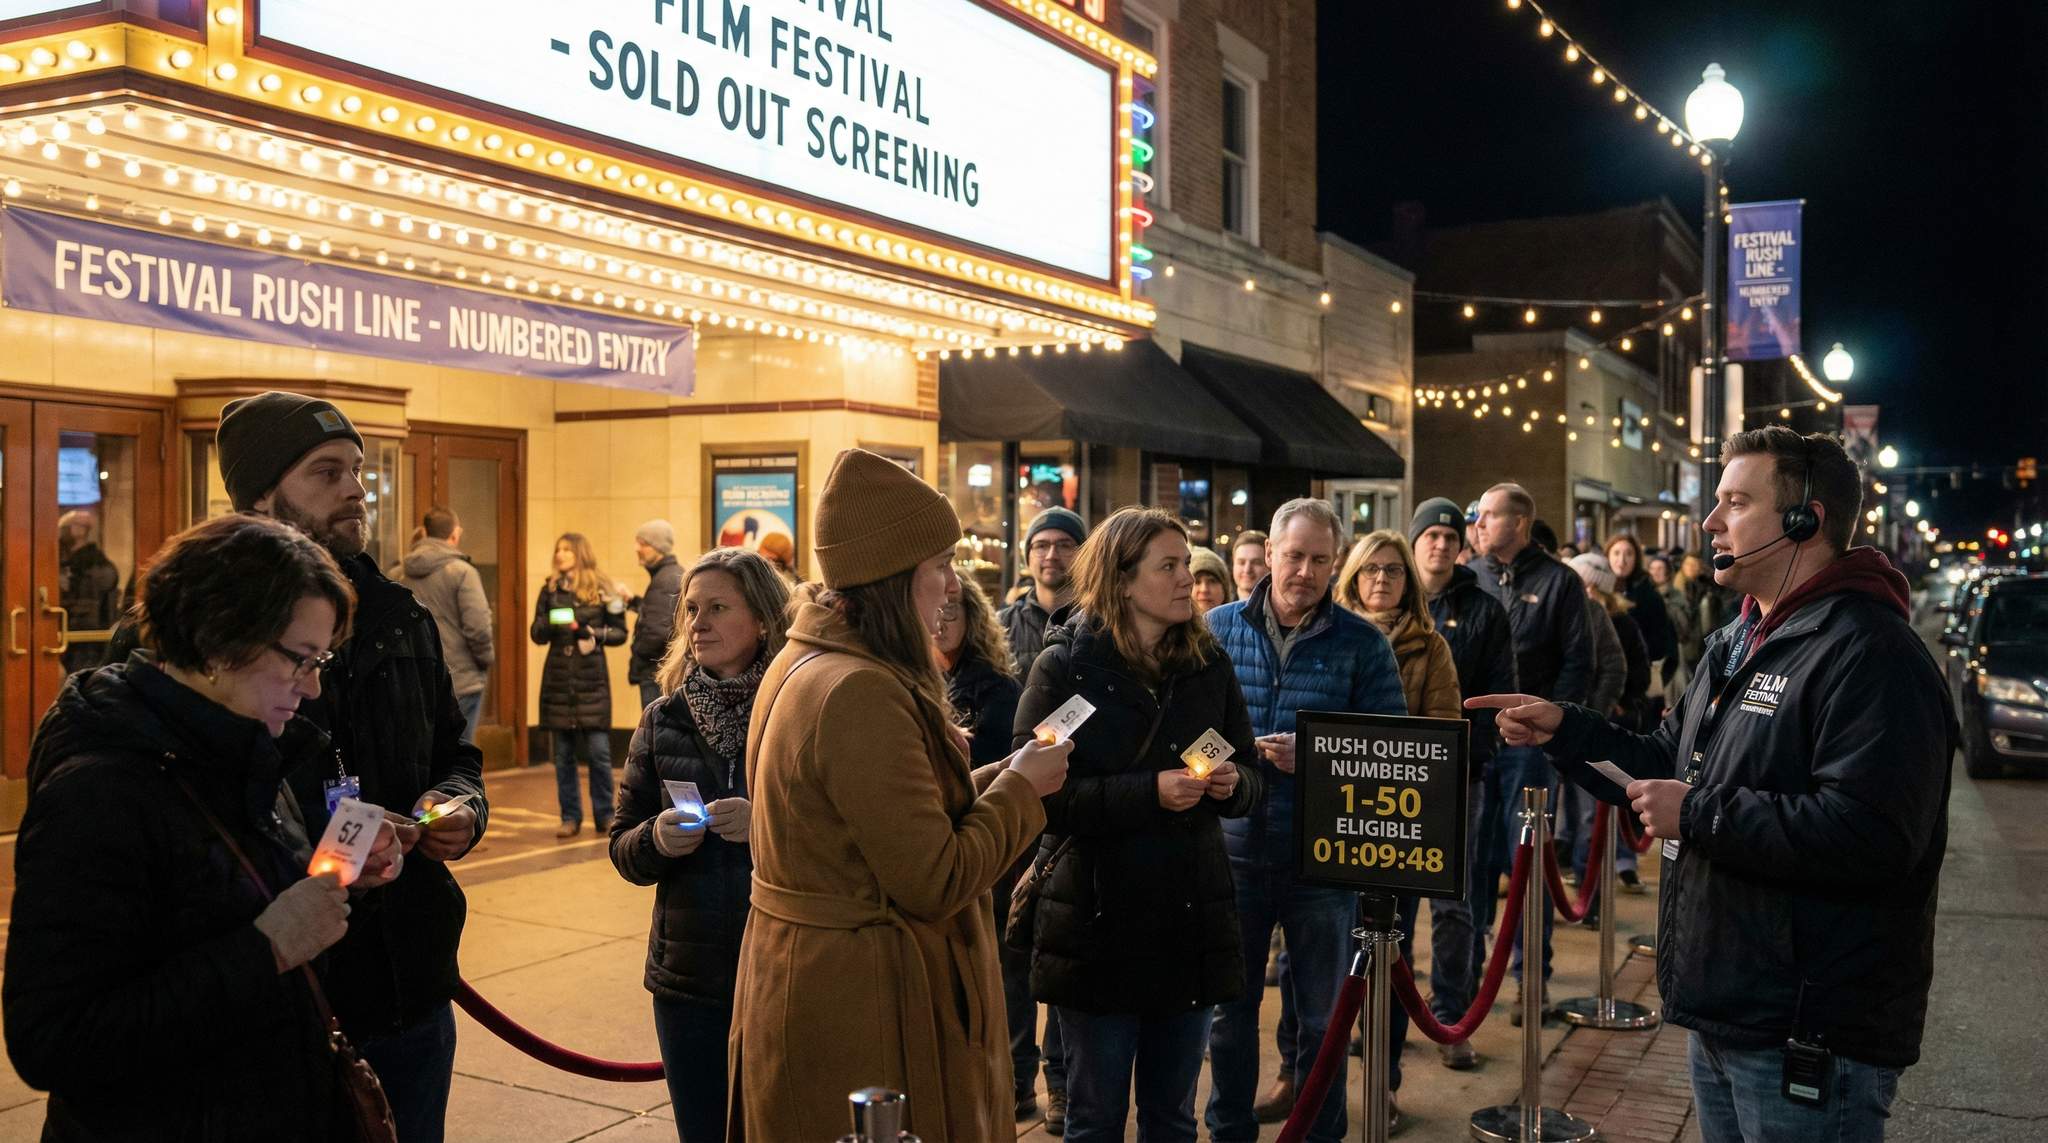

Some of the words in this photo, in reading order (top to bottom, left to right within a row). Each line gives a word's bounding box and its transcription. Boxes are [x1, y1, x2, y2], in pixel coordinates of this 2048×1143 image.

[771, 16, 930, 126] FESTIVAL
[589, 30, 700, 116] SOLD
[717, 76, 790, 146] OUT
[807, 107, 979, 208] SCREENING
[1733, 230, 1796, 249] FESTIVAL
[1746, 246, 1783, 262] RUSH
[1745, 261, 1776, 278] LINE
[55, 239, 242, 317] FESTIVAL
[252, 273, 344, 332] RUSH
[354, 290, 421, 342] LINE
[449, 306, 592, 366] NUMBERED
[597, 331, 671, 377] ENTRY
[1749, 672, 1788, 693] FILM
[1314, 736, 1367, 755] RUSH
[1372, 739, 1448, 761] QUEUE:
[1331, 760, 1429, 782] NUMBERS
[1340, 783, 1422, 819] 1-50
[337, 820, 363, 847] 52
[1336, 817, 1422, 840] ELIGIBLE
[1313, 837, 1444, 873] 01:09:48
